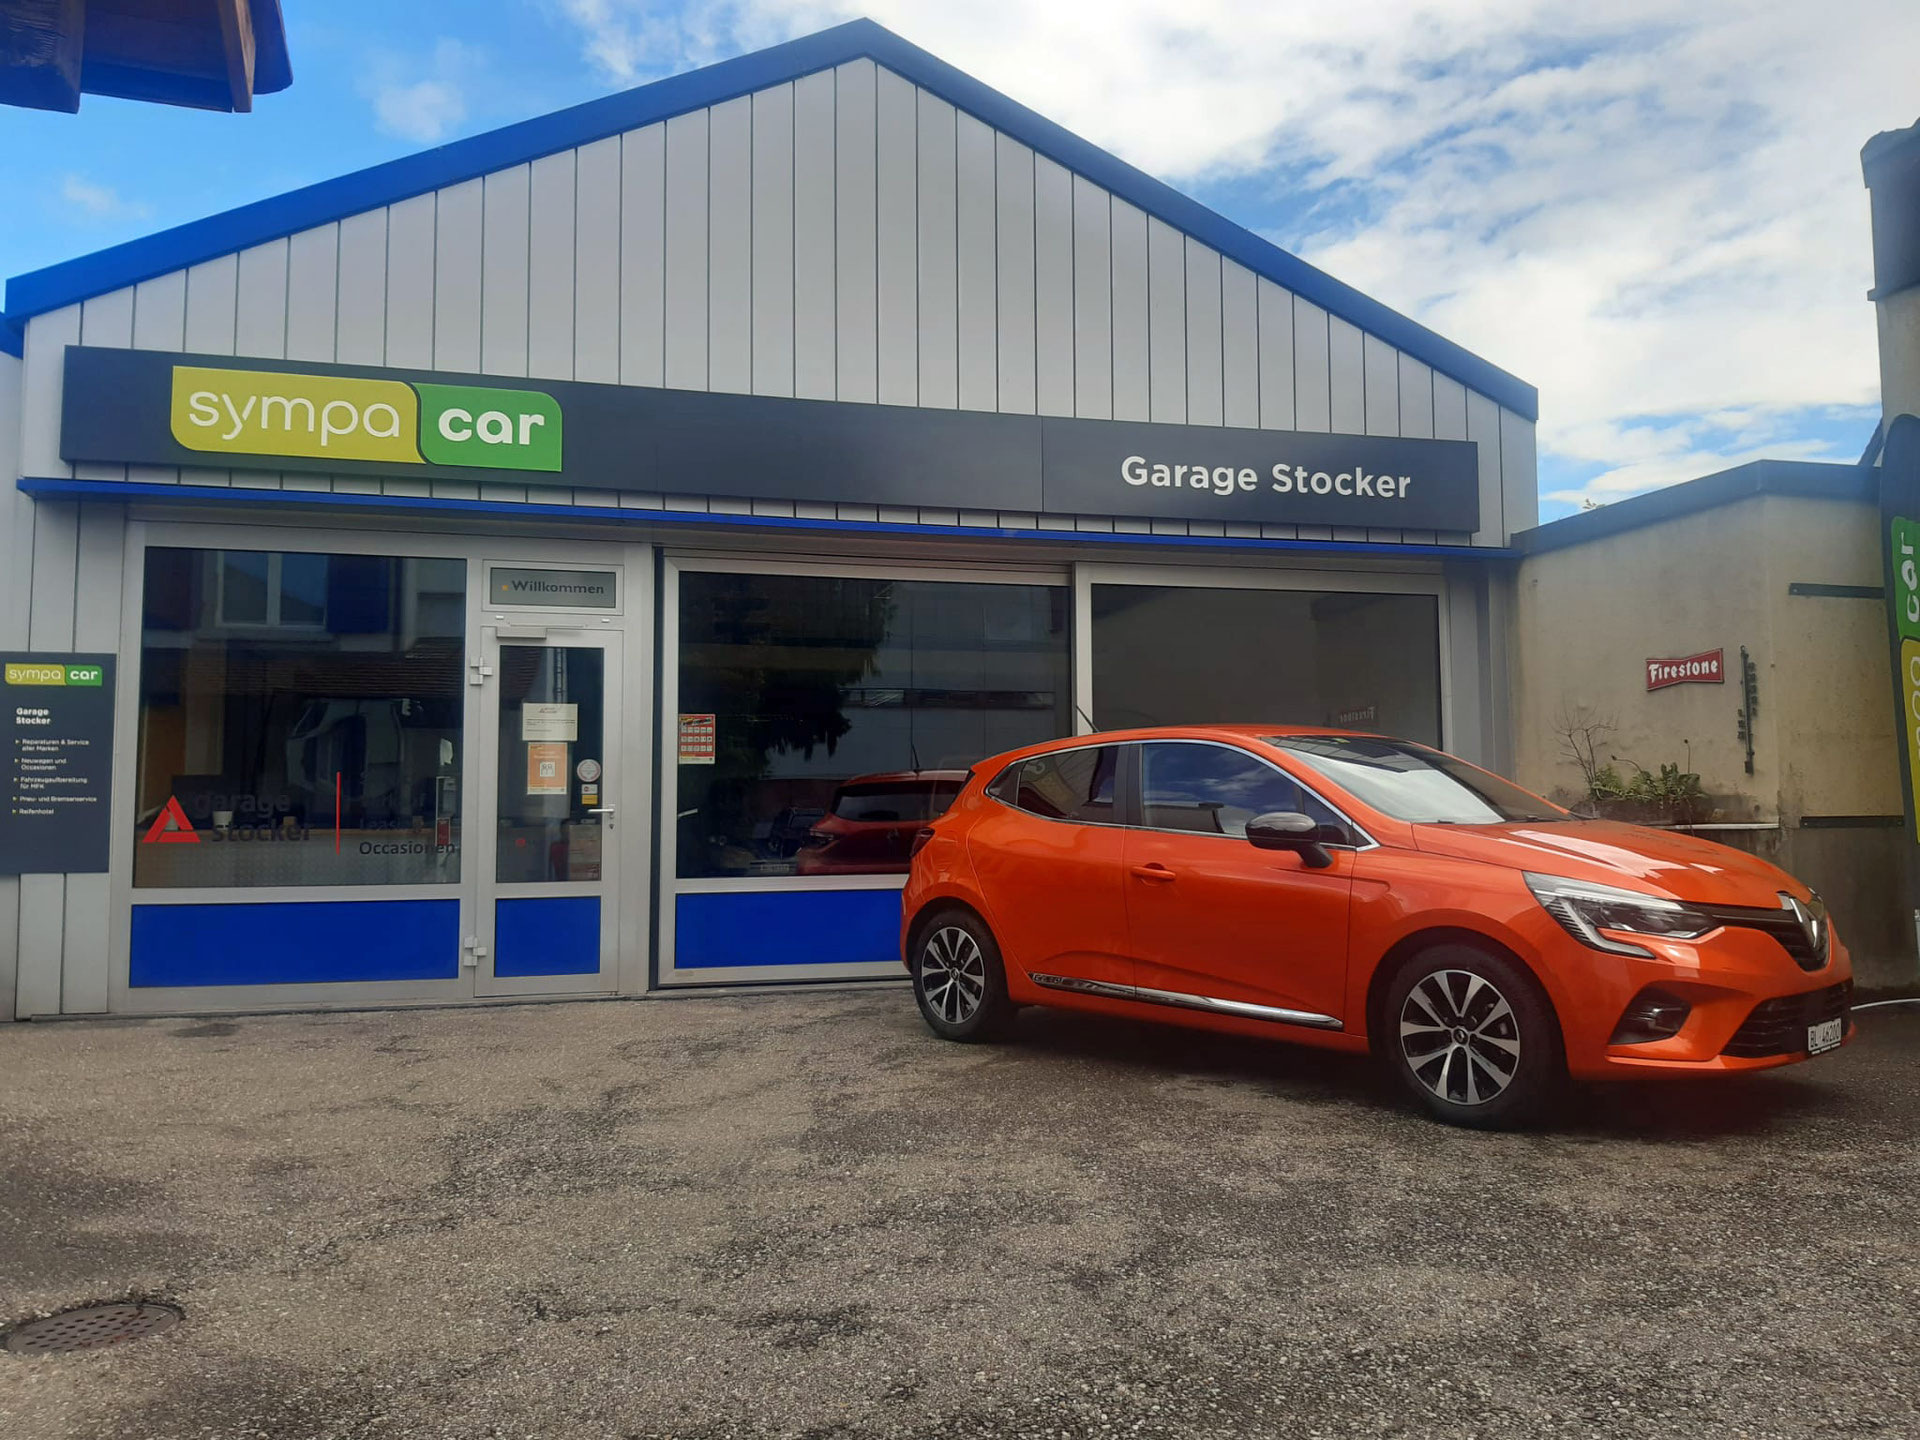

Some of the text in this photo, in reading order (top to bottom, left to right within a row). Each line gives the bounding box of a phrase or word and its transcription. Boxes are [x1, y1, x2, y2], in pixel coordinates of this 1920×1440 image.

[189, 390, 546, 446] sympa car
[1120, 455, 1411, 498] Garage Stocker
[511, 579, 605, 595] Willkommen
[9, 667, 98, 682] sympa car
[1648, 659, 1718, 683] Firestone
[16, 707, 49, 717] Garage
[16, 716, 51, 725] Stocker
